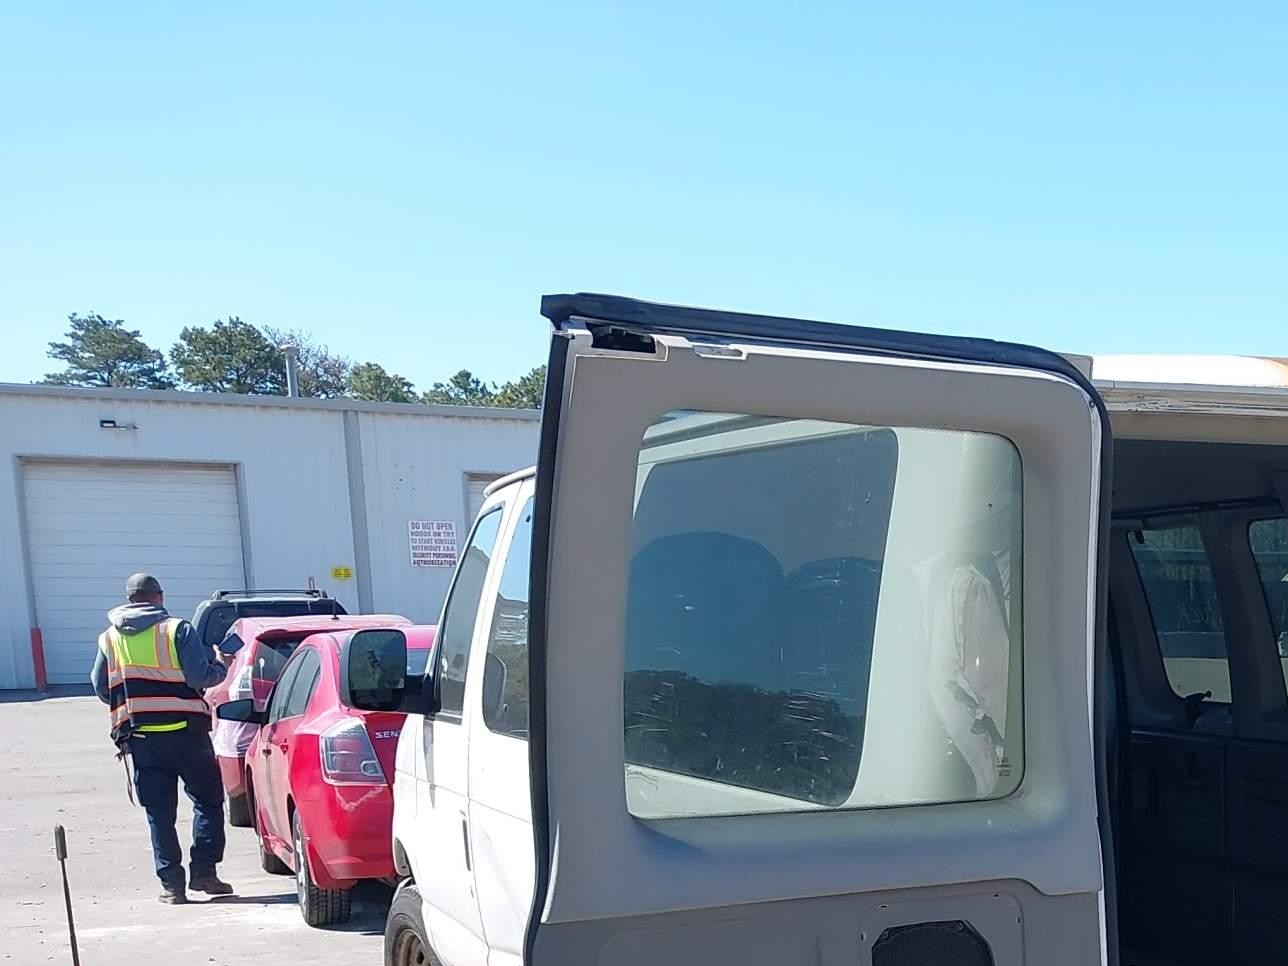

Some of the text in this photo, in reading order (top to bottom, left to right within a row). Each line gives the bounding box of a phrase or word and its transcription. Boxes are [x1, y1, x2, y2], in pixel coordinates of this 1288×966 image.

[411, 522, 453, 530] DO NOT OPEN
[375, 730, 400, 739] SEN
